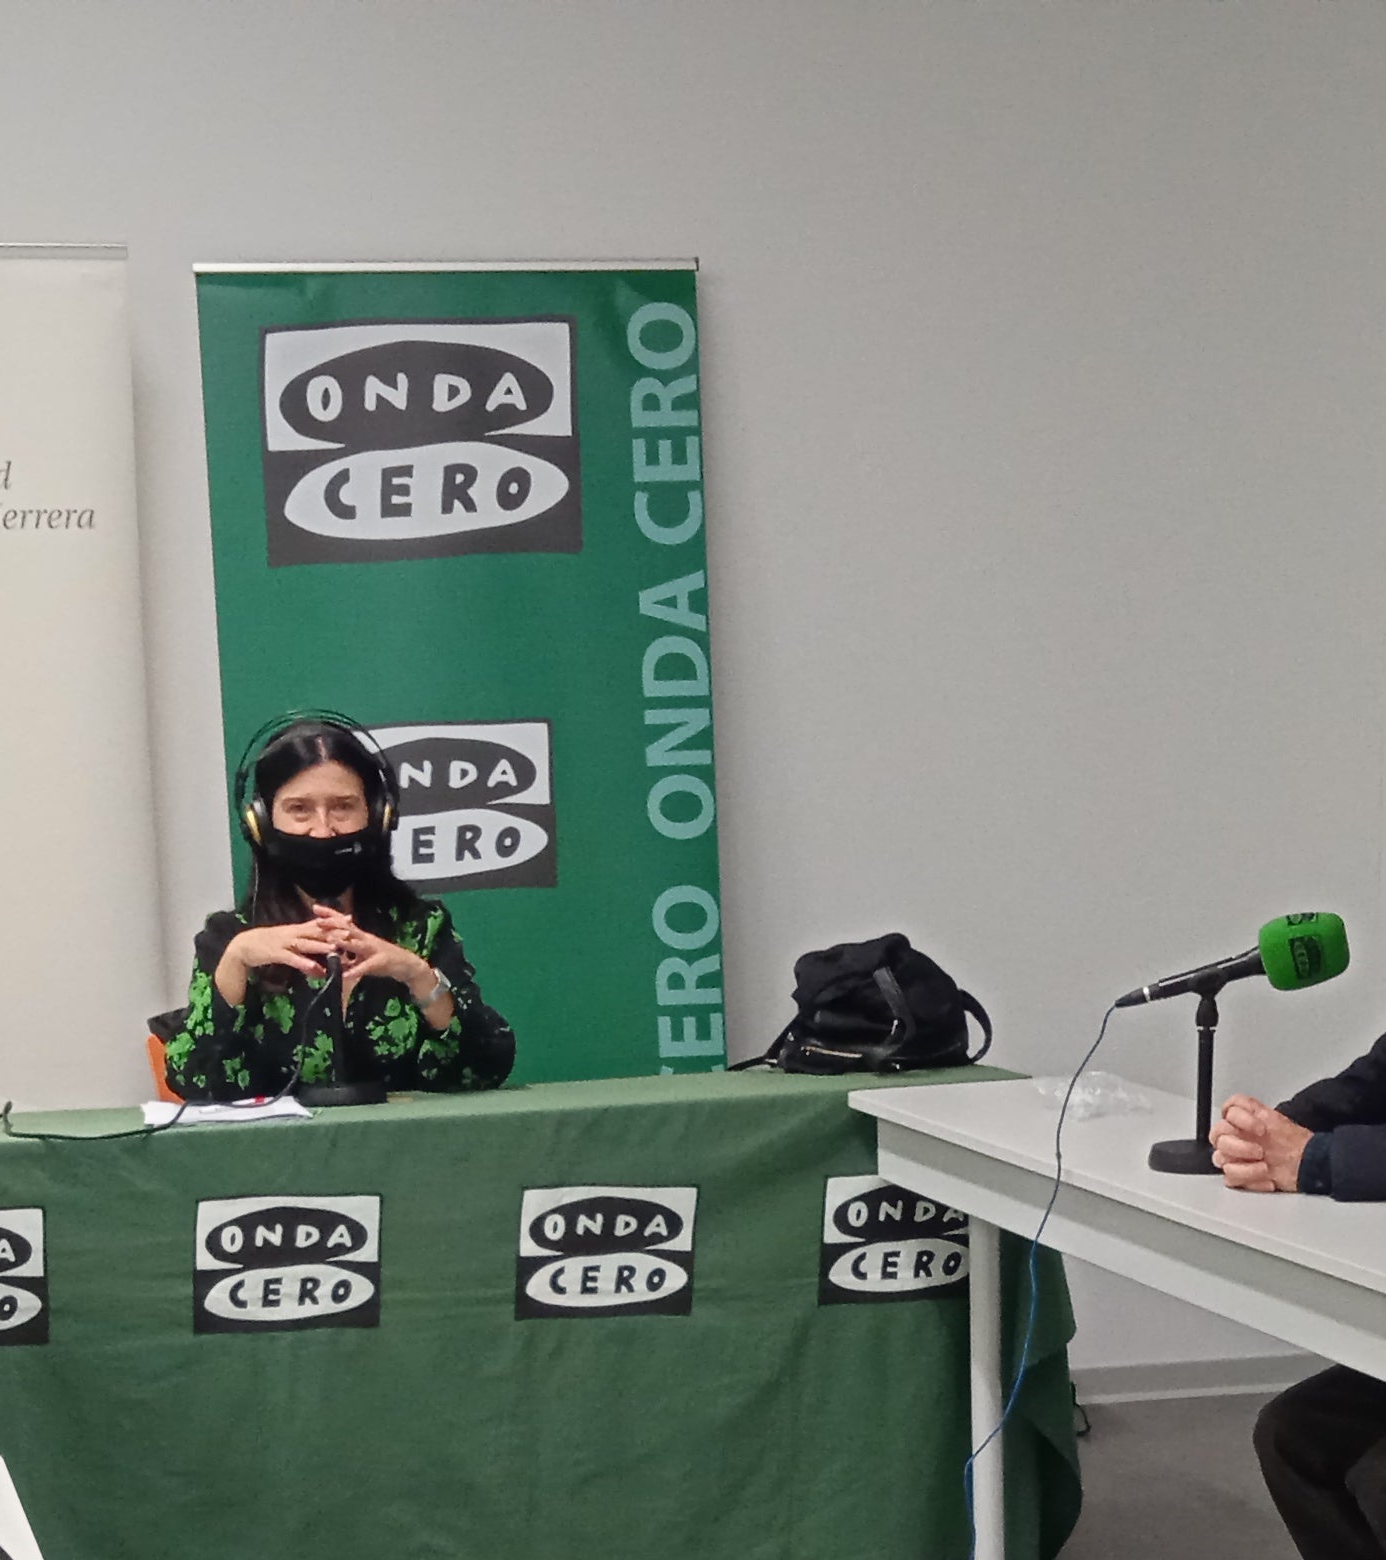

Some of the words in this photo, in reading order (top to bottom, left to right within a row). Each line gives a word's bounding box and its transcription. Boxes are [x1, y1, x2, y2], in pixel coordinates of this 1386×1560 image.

[306, 371, 528, 423] ONDA
[626, 301, 702, 545] CERO
[324, 463, 533, 521] CERO
[638, 569, 716, 840] ONDA
[399, 758, 518, 789] NDA
[411, 823, 522, 865] ERO
[652, 884, 726, 1075] ERO
[220, 1222, 353, 1255] ONDA
[543, 1212, 670, 1242] ONDA
[549, 1263, 667, 1295] CERO
[851, 1250, 963, 1280] CERO
[229, 1276, 353, 1310] CERO
